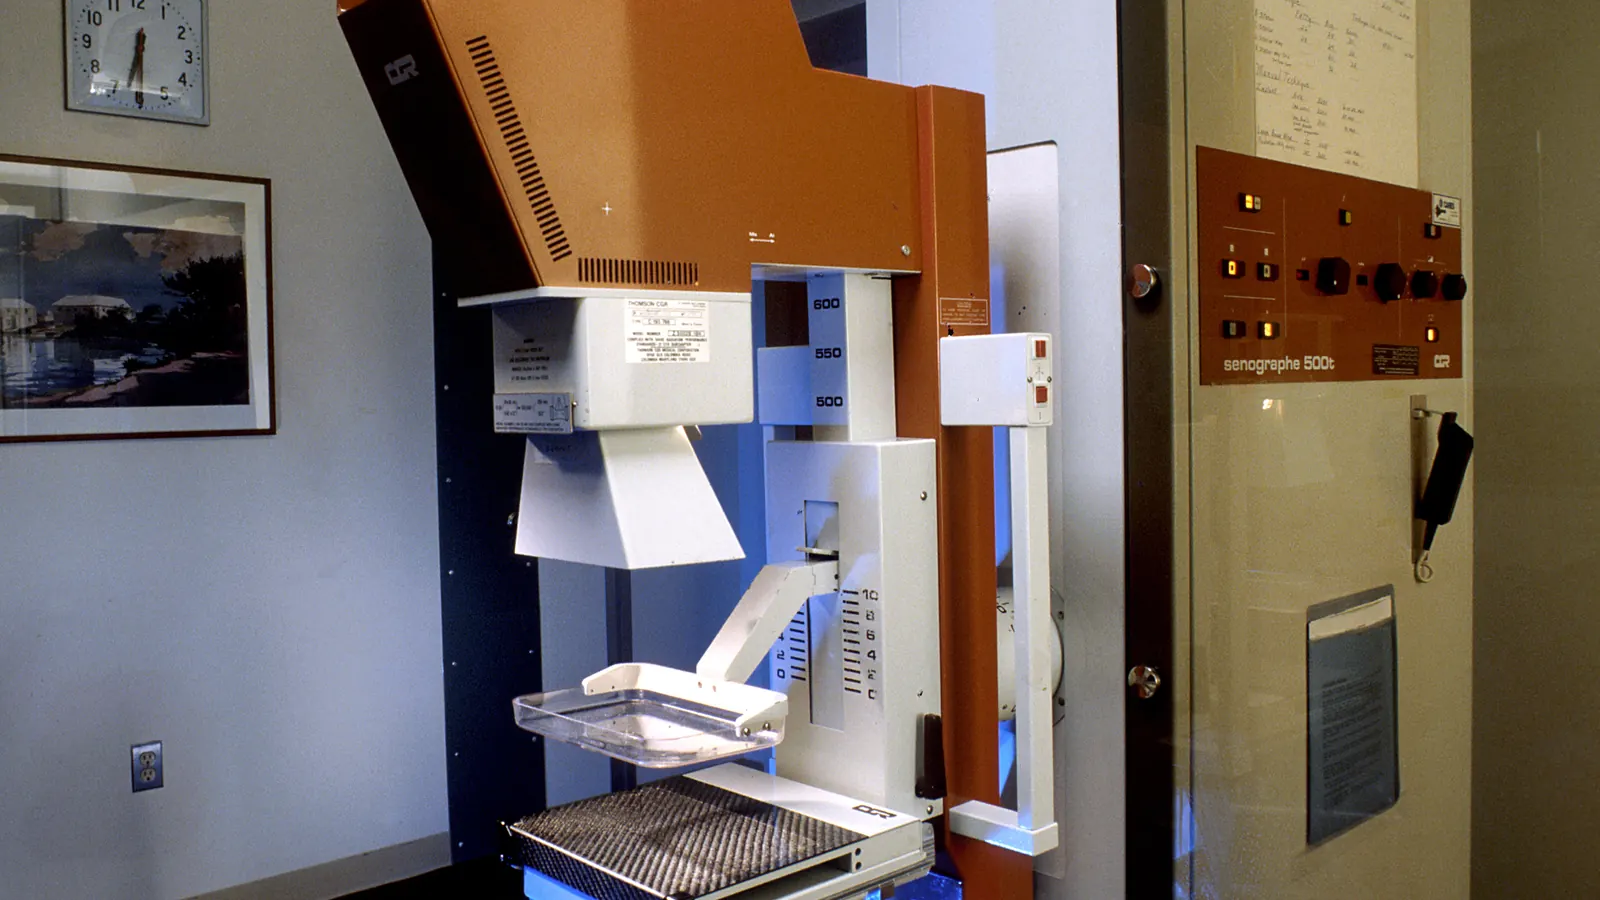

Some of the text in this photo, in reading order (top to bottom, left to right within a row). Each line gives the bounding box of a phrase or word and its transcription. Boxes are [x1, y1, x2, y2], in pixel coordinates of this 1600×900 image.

[87, 11, 102, 26] 10
[161, 5, 166, 20] 1
[177, 26, 186, 40] 2
[82, 34, 92, 49] 9
[184, 49, 193, 64] 3
[91, 59, 100, 73] 8
[178, 72, 187, 87] 4
[110, 80, 119, 94] 7
[160, 86, 169, 100] 5
[813, 298, 840, 310] 600
[815, 347, 842, 359] 550
[1223, 355, 1336, 375] senographe 500t
[816, 396, 844, 408] 500
[862, 589, 879, 601] 10
[866, 630, 876, 641] 6
[777, 650, 785, 660] 2
[867, 650, 876, 661] 4
[777, 668, 786, 679] 0
